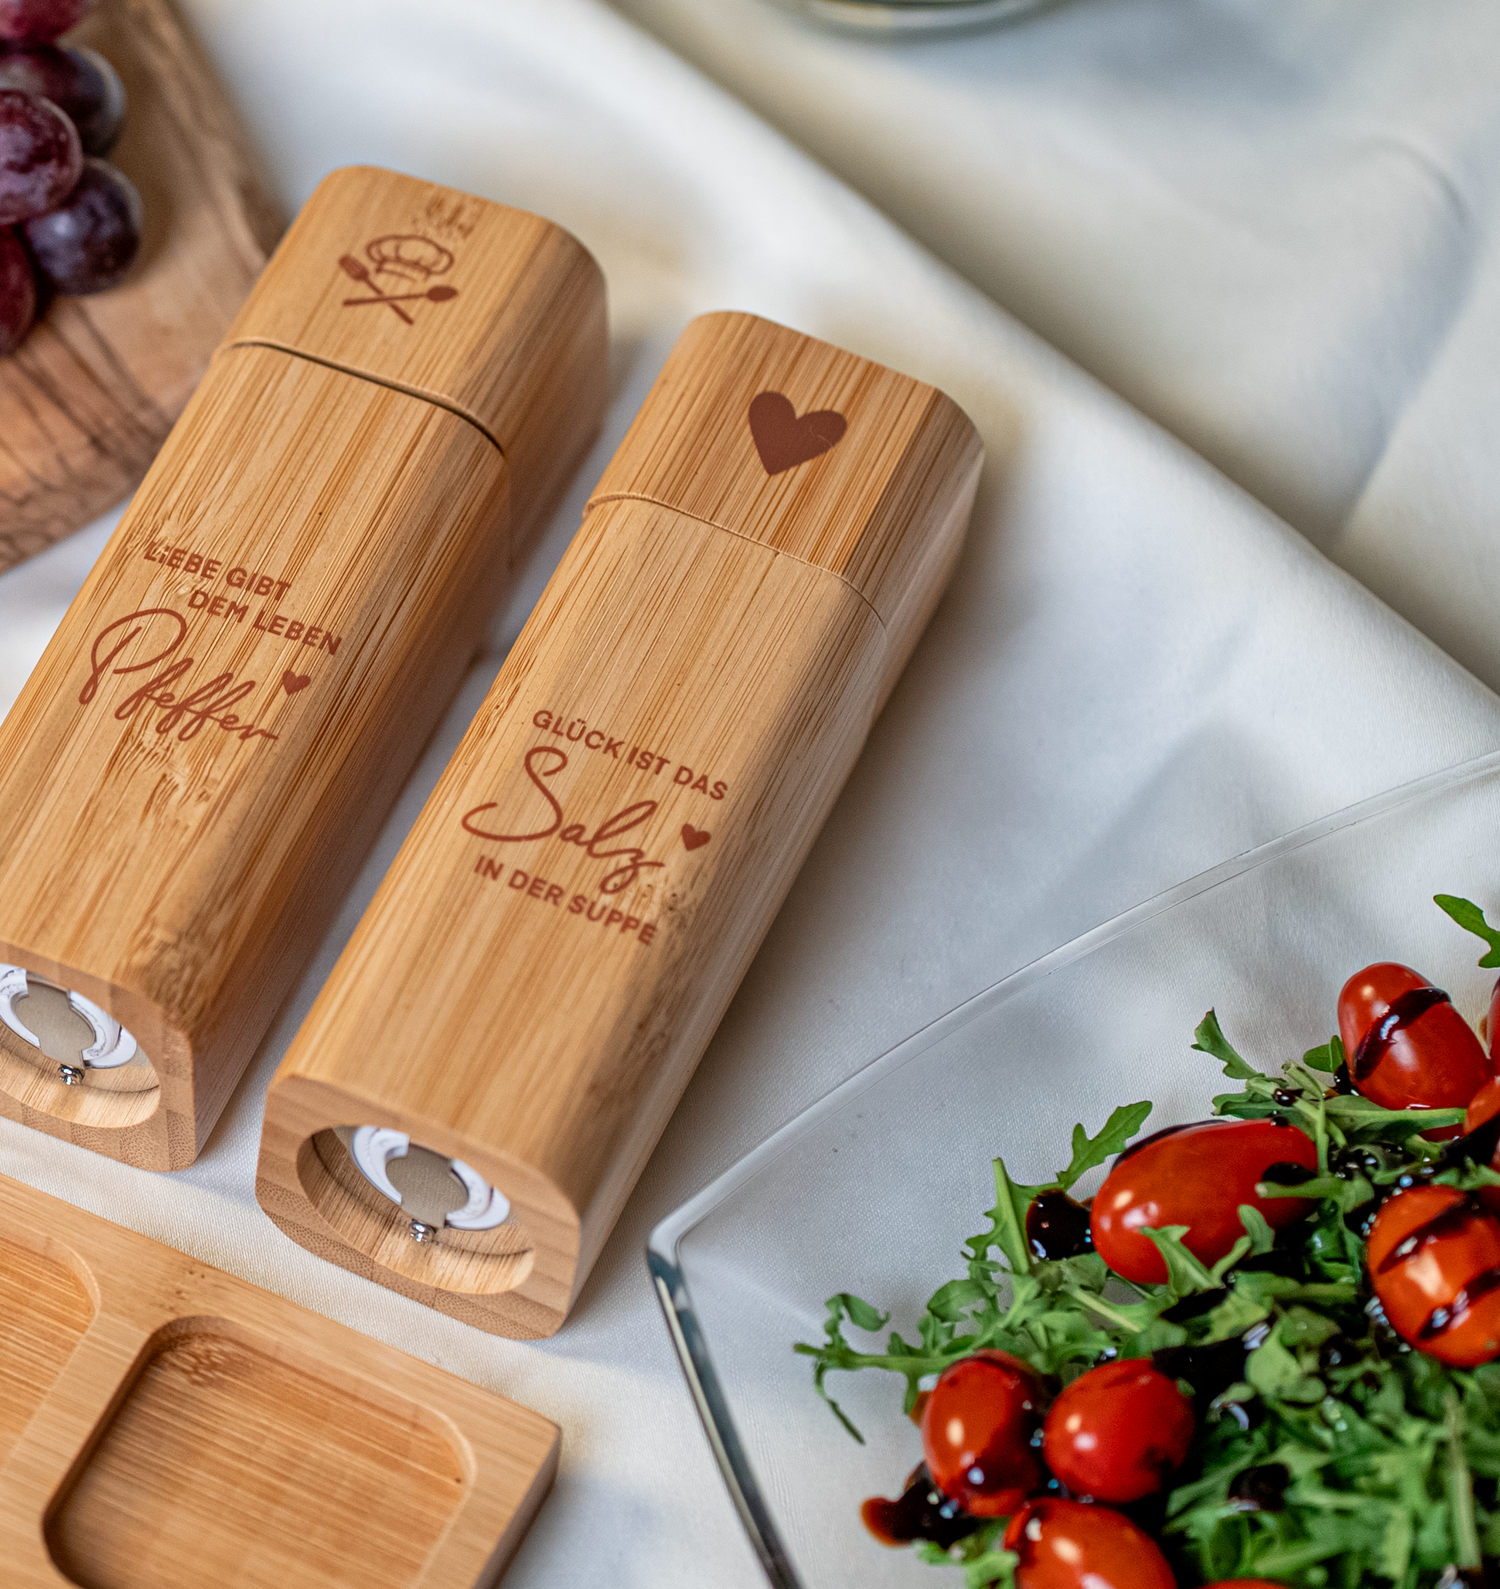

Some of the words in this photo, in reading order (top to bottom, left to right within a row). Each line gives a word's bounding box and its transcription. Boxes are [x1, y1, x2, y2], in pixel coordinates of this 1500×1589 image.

[143, 541, 222, 580] LIEBE
[226, 567, 292, 601] GIBT
[187, 590, 249, 623] DEM
[253, 610, 342, 656] LEBEN
[78, 608, 279, 742] Pfeffer
[532, 709, 625, 759] GLÜCK
[627, 747, 670, 775] IST
[673, 766, 729, 801] DAS
[461, 746, 666, 894] Salz
[474, 855, 504, 881] IN
[508, 869, 565, 906] DER
[568, 895, 657, 946] SUPPE
